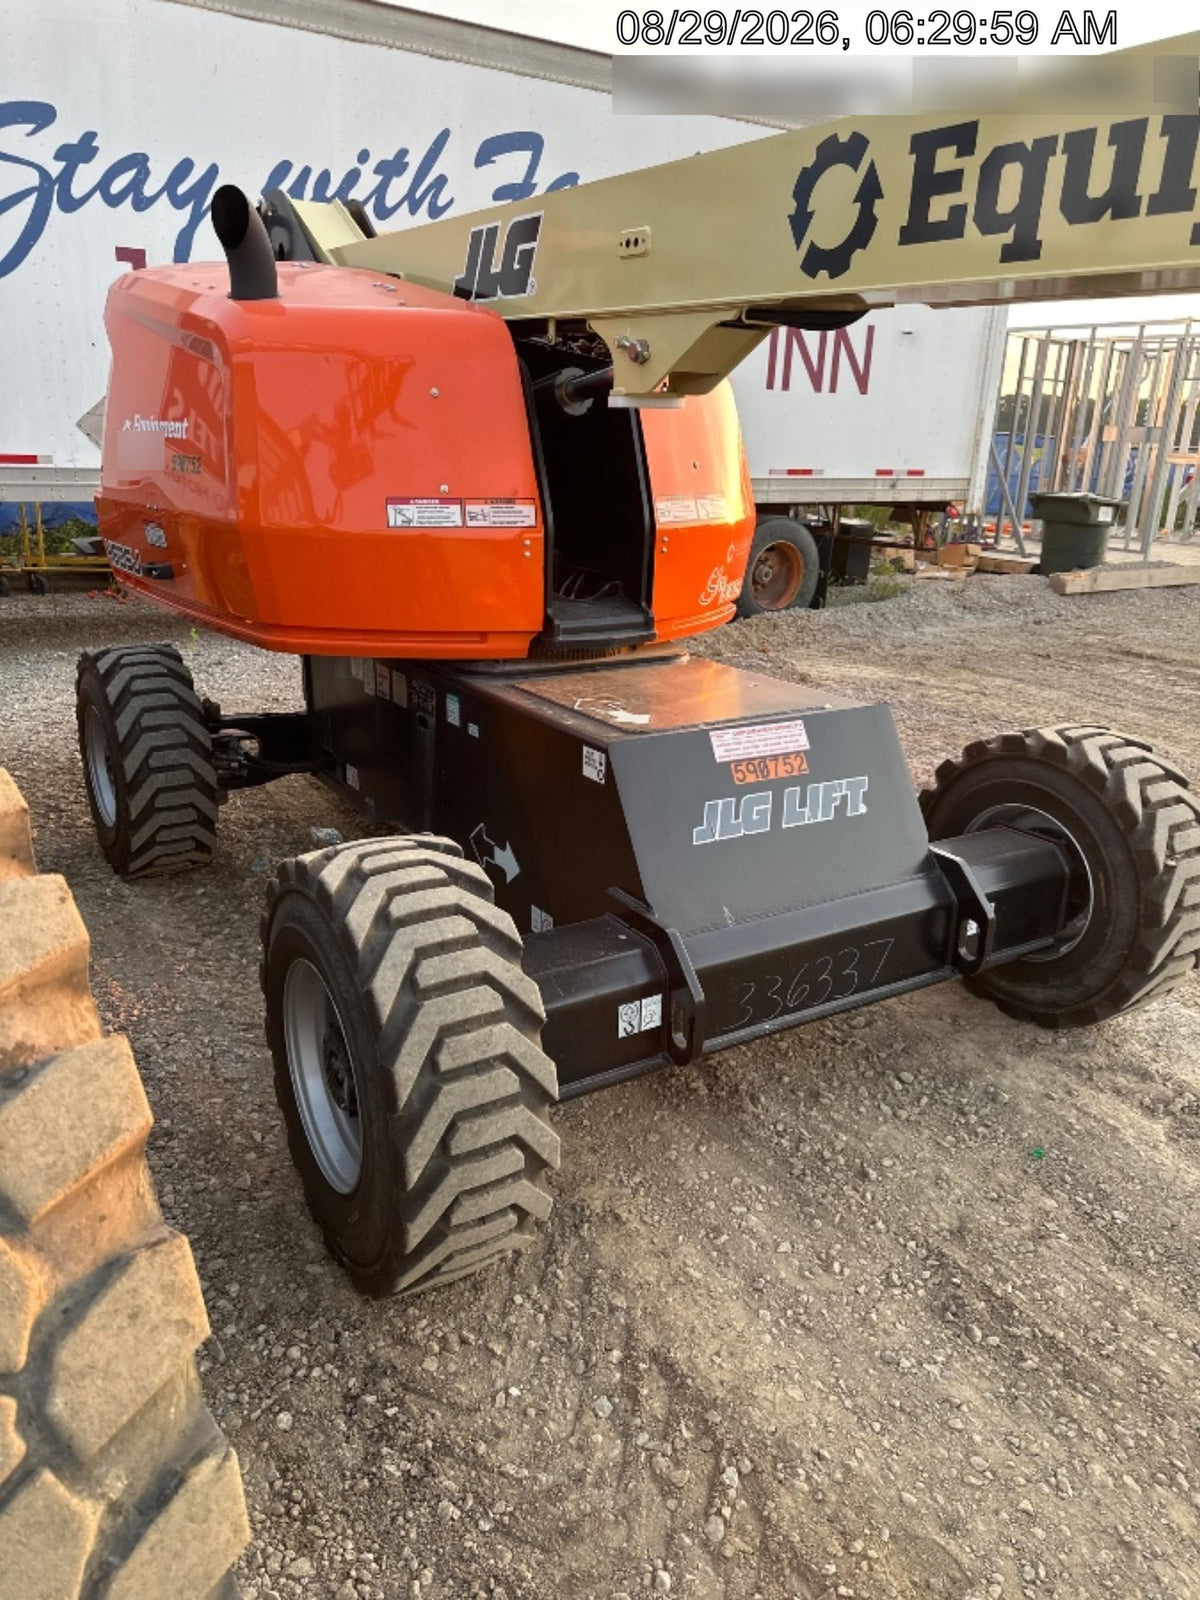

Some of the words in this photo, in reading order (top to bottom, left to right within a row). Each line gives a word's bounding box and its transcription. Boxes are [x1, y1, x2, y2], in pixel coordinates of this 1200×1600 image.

[0, 100, 219, 278] Stay
[261, 127, 454, 221] with
[897, 112, 1200, 264] Equi
[452, 209, 544, 302] JLG
[693, 791, 772, 845] JLG
[782, 775, 868, 829] LIFT
[732, 752, 808, 784] 590752
[722, 937, 895, 1030] 336337
